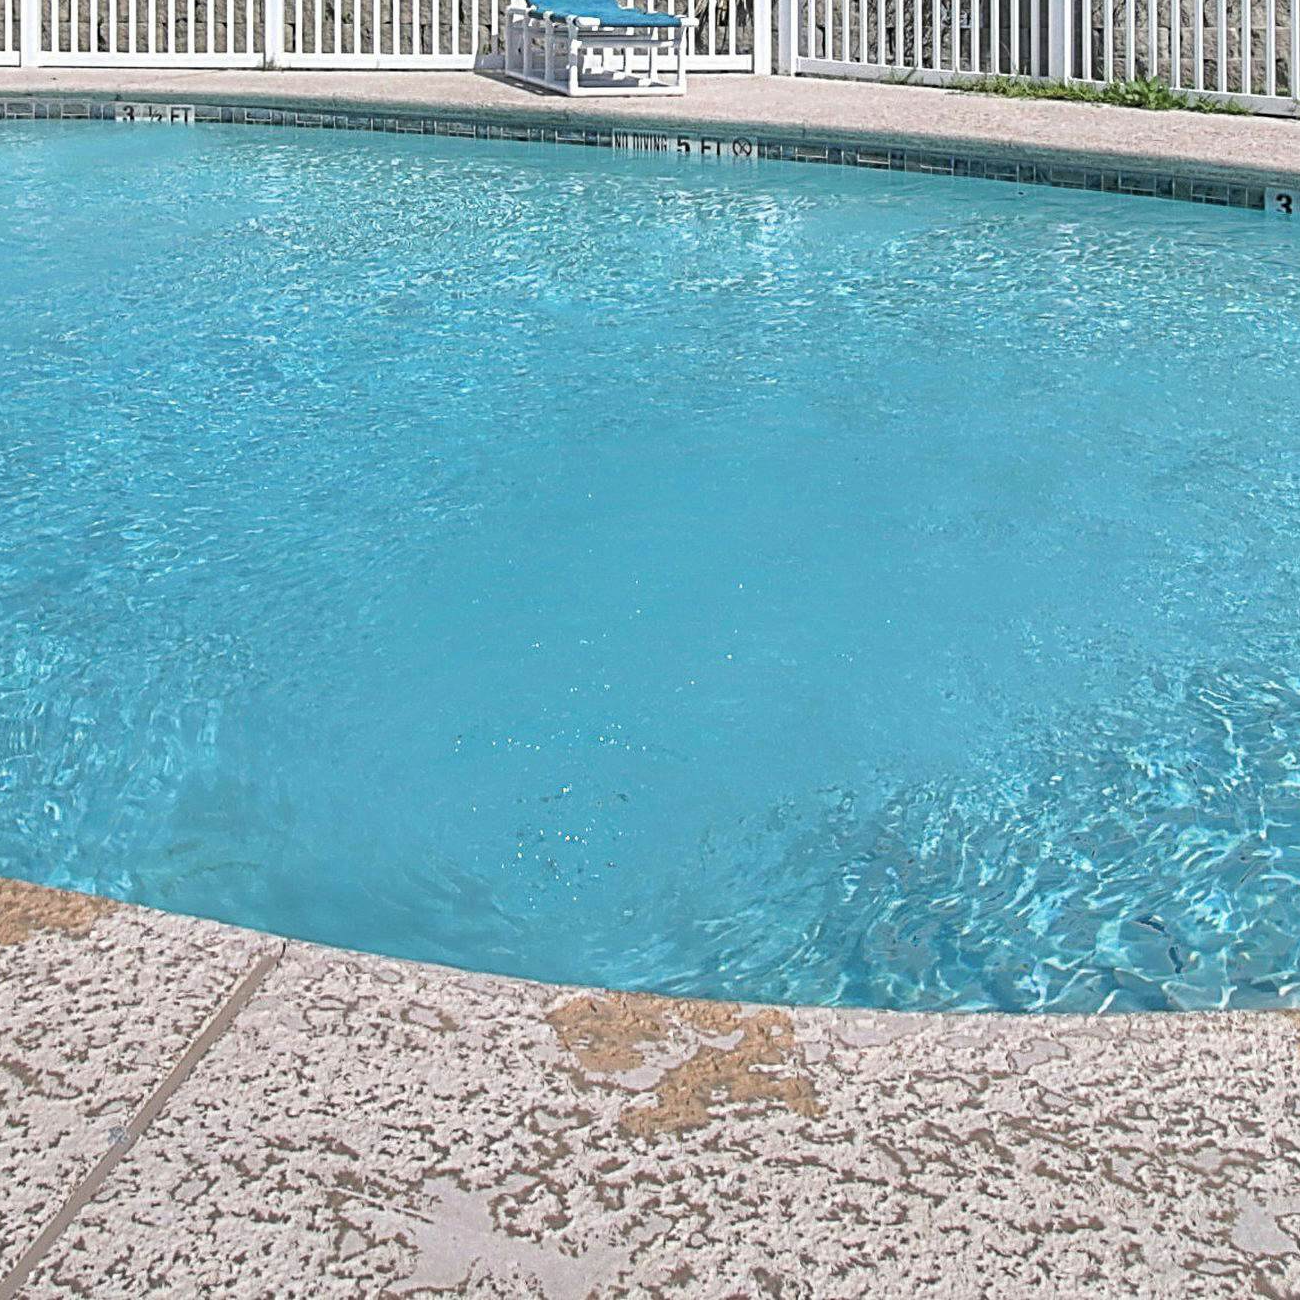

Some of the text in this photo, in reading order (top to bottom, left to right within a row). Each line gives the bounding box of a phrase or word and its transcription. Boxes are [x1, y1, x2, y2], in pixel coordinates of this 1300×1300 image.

[123, 105, 134, 121] 3
[171, 107, 191, 123] FT
[615, 131, 724, 156] NO DIVING 5 FT
[1275, 193, 1293, 215] 3
